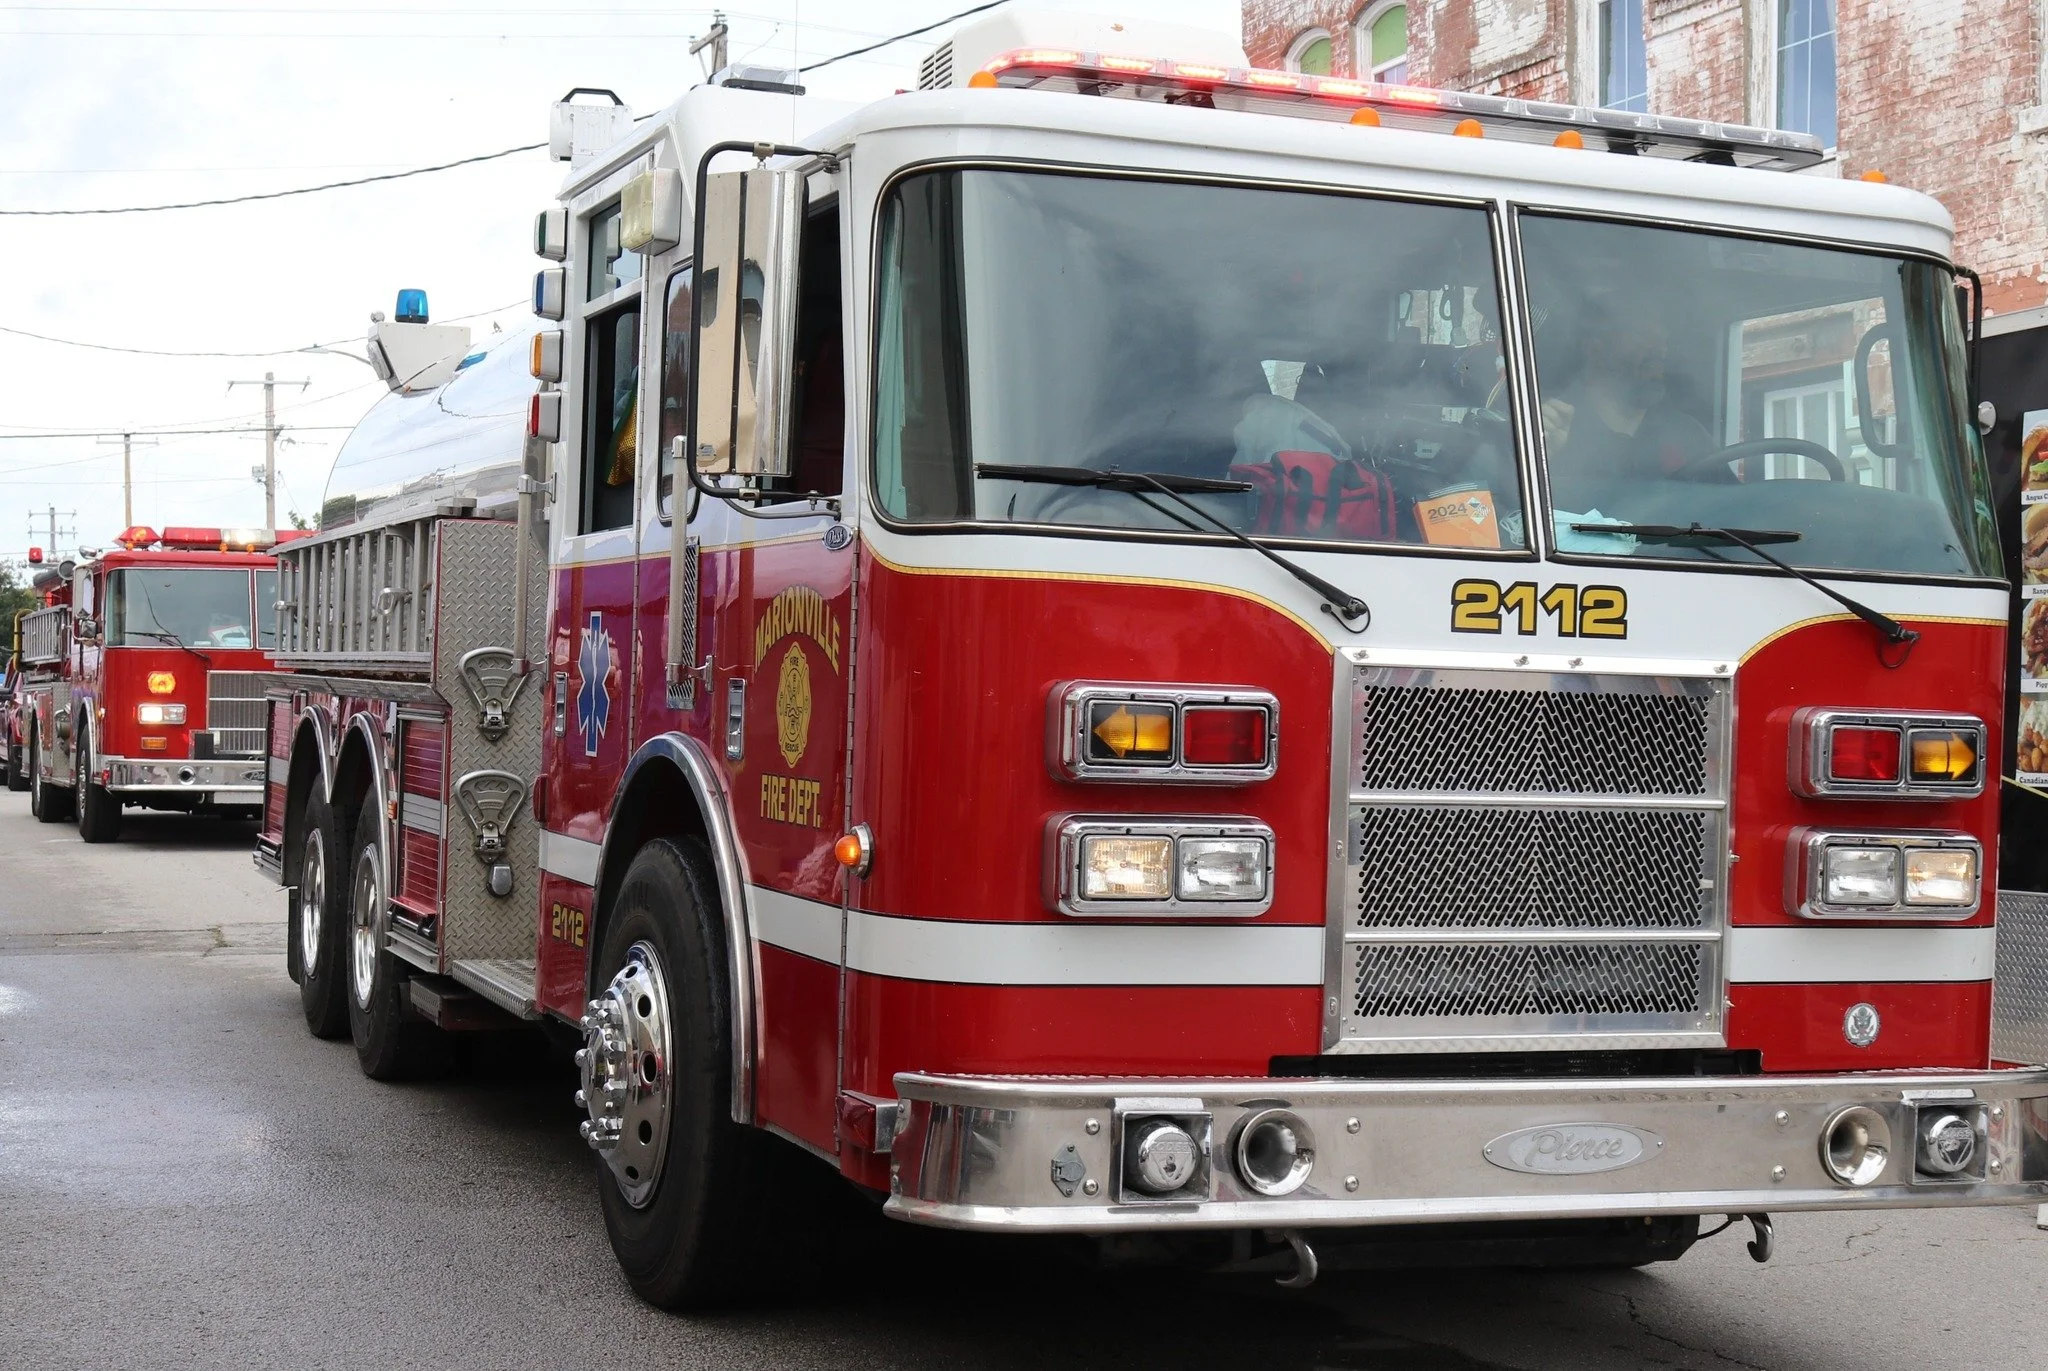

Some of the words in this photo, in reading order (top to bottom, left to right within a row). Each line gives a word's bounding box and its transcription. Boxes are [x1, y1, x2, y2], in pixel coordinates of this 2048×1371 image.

[1427, 502, 1468, 520] 2024
[754, 585, 840, 675] MARIONVILLE
[1451, 578, 1627, 640] 2112
[760, 773, 787, 822] FIRE
[788, 777, 821, 829] DEPT.
[552, 902, 584, 948] 2112
[1525, 1129, 1624, 1167] Pierce
